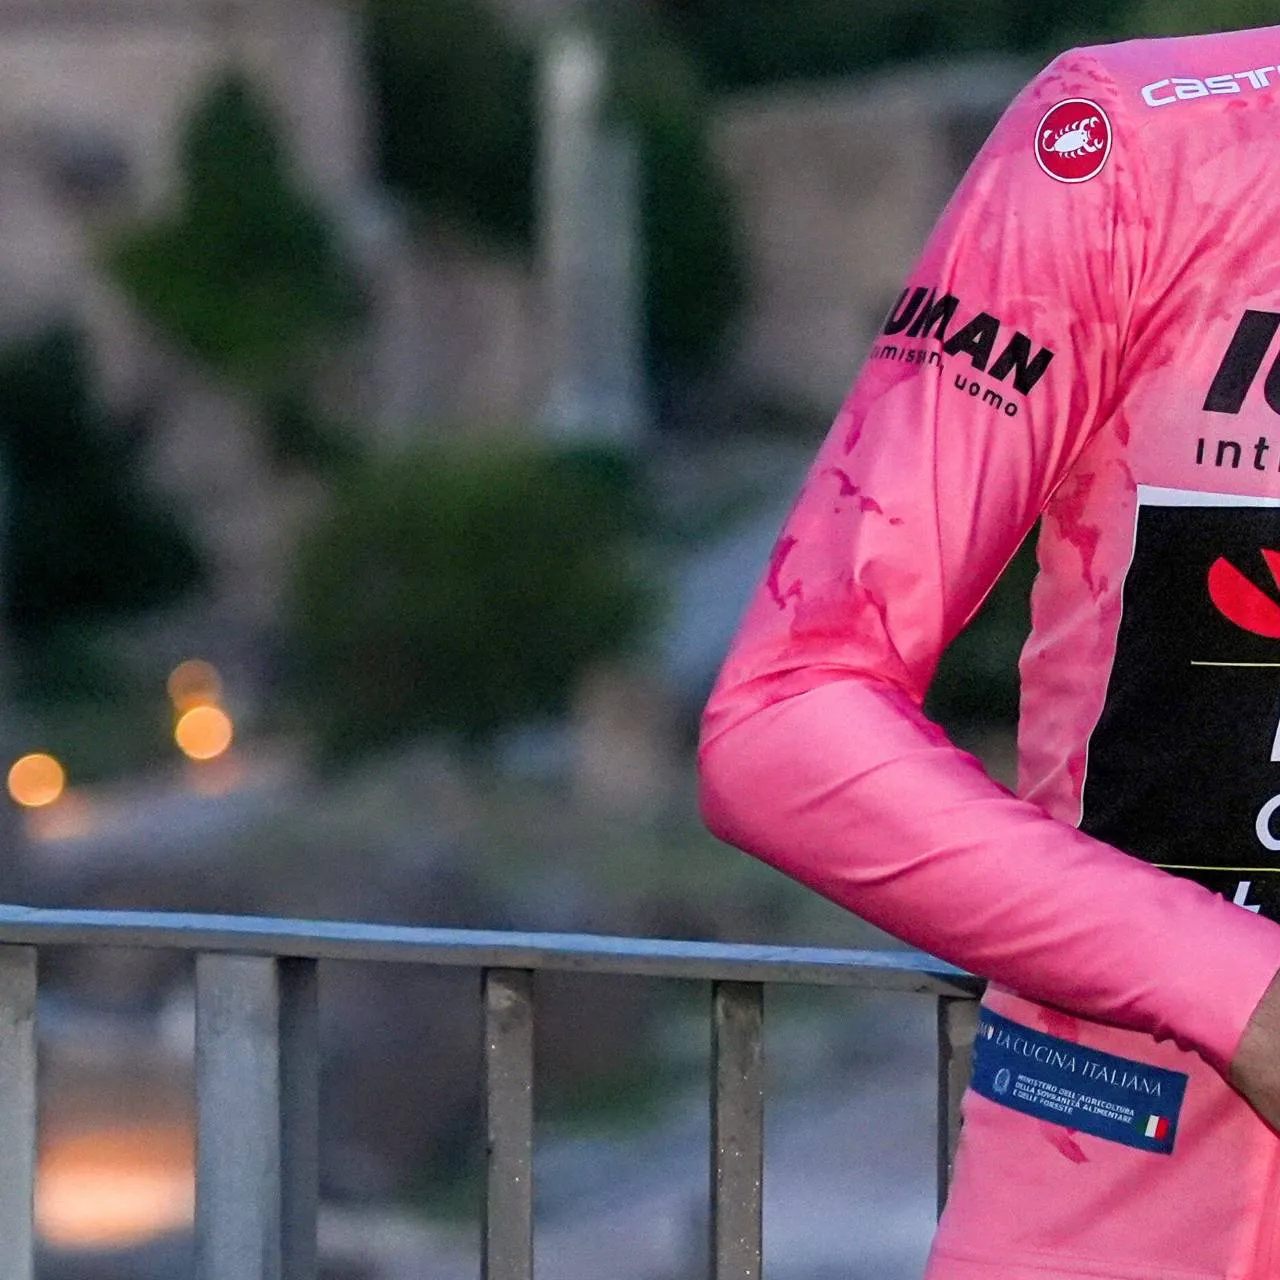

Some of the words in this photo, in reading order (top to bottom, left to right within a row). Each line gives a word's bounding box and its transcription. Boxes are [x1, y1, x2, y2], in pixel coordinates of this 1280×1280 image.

[954, 374, 1018, 417] uomo
[1013, 1037, 1076, 1073] CUCINA
[1082, 1059, 1161, 1097] ITALIANA
